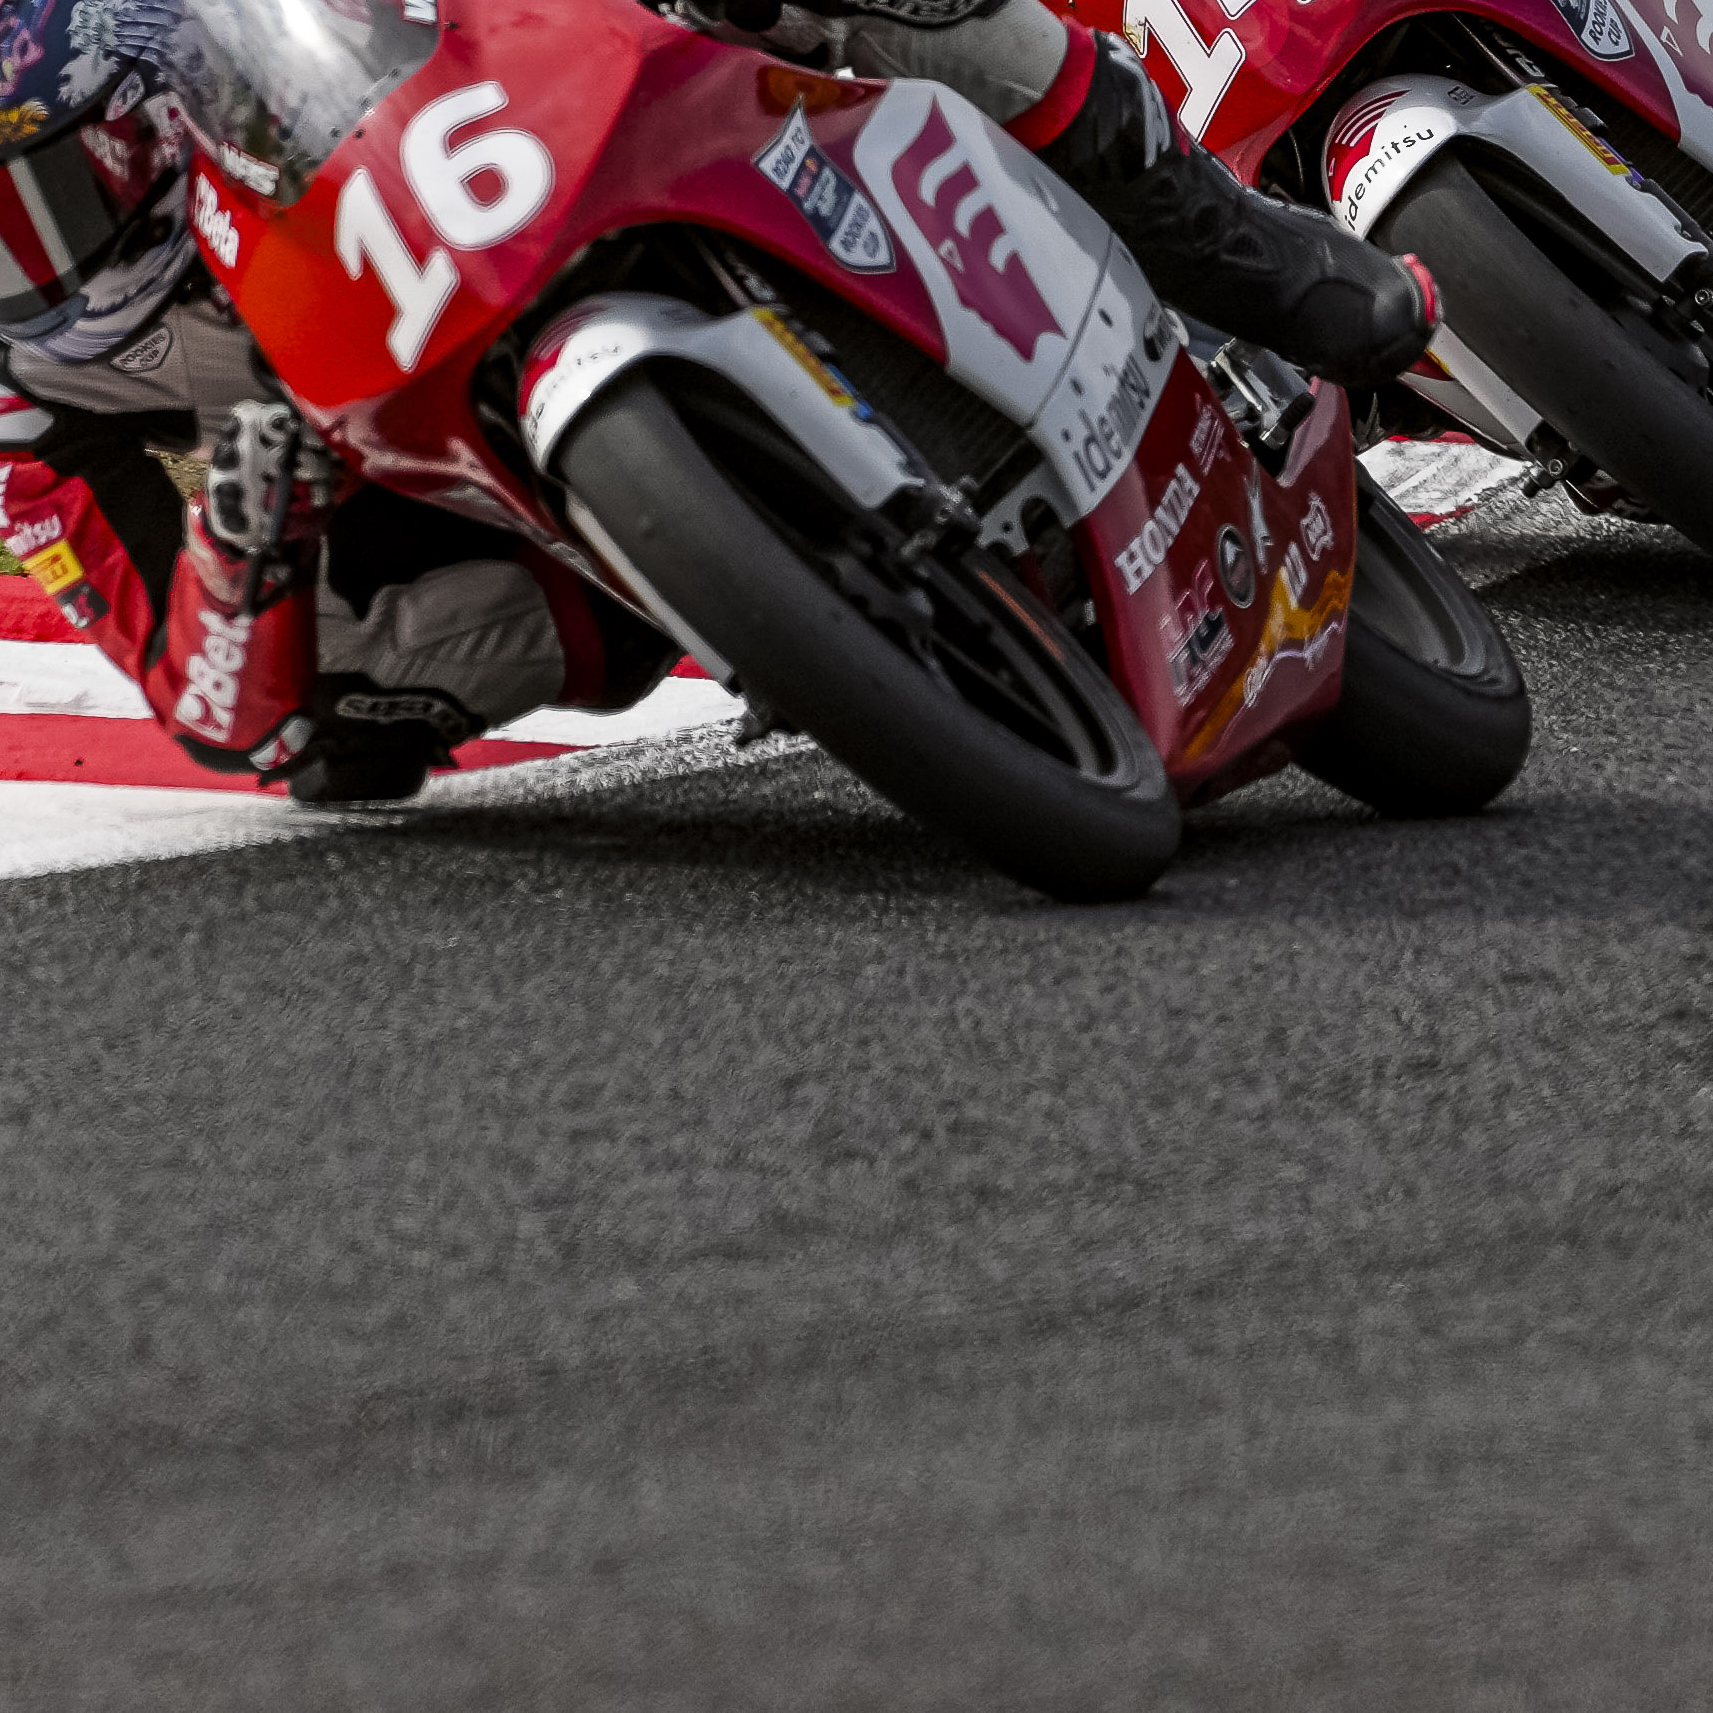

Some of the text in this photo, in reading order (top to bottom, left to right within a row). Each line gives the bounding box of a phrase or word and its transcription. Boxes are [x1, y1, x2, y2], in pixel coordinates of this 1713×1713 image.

[1607, 17, 1623, 47] CUP
[334, 80, 557, 375] 16
[1344, 124, 1435, 232] idemitsu
[1114, 463, 1201, 595] HONDA
